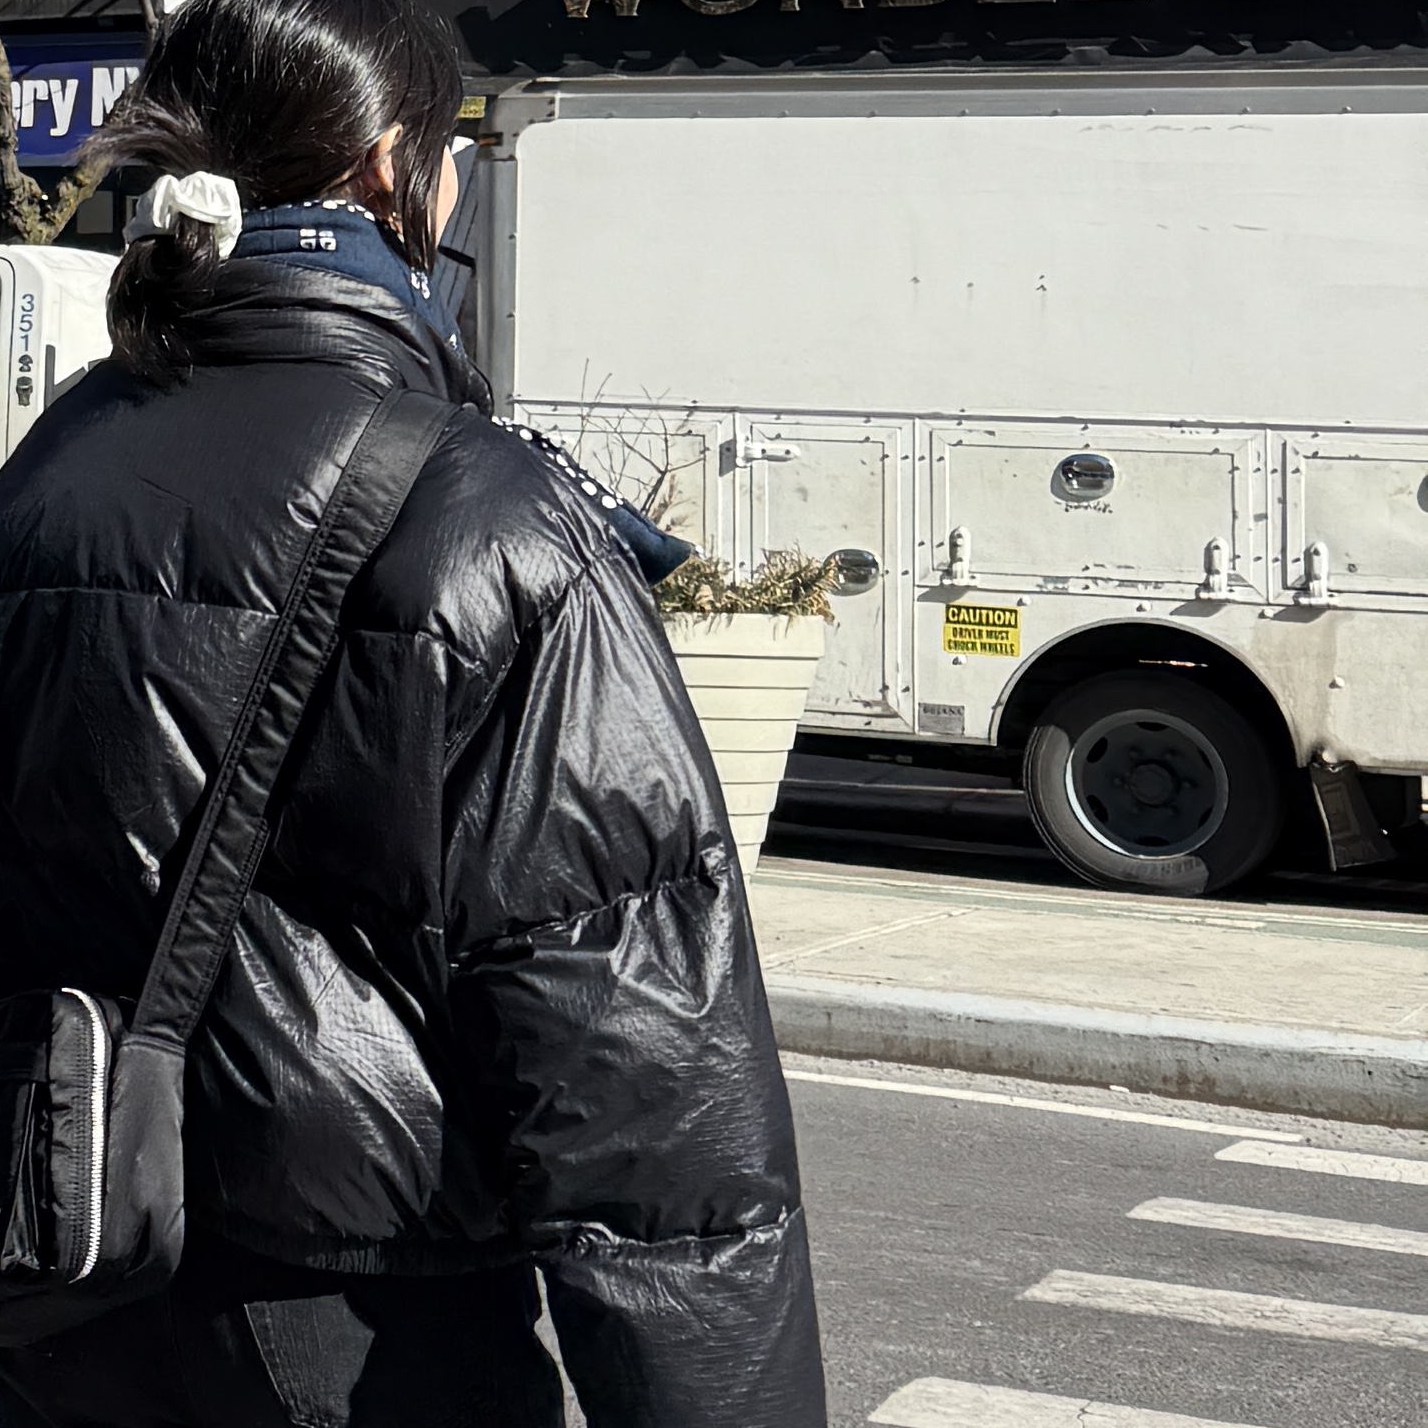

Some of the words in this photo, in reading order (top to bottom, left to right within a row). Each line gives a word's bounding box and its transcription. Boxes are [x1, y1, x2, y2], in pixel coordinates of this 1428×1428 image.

[948, 607, 1016, 625] CAUTION
[952, 627, 983, 639] DRIVER
[986, 629, 1009, 641] MUST
